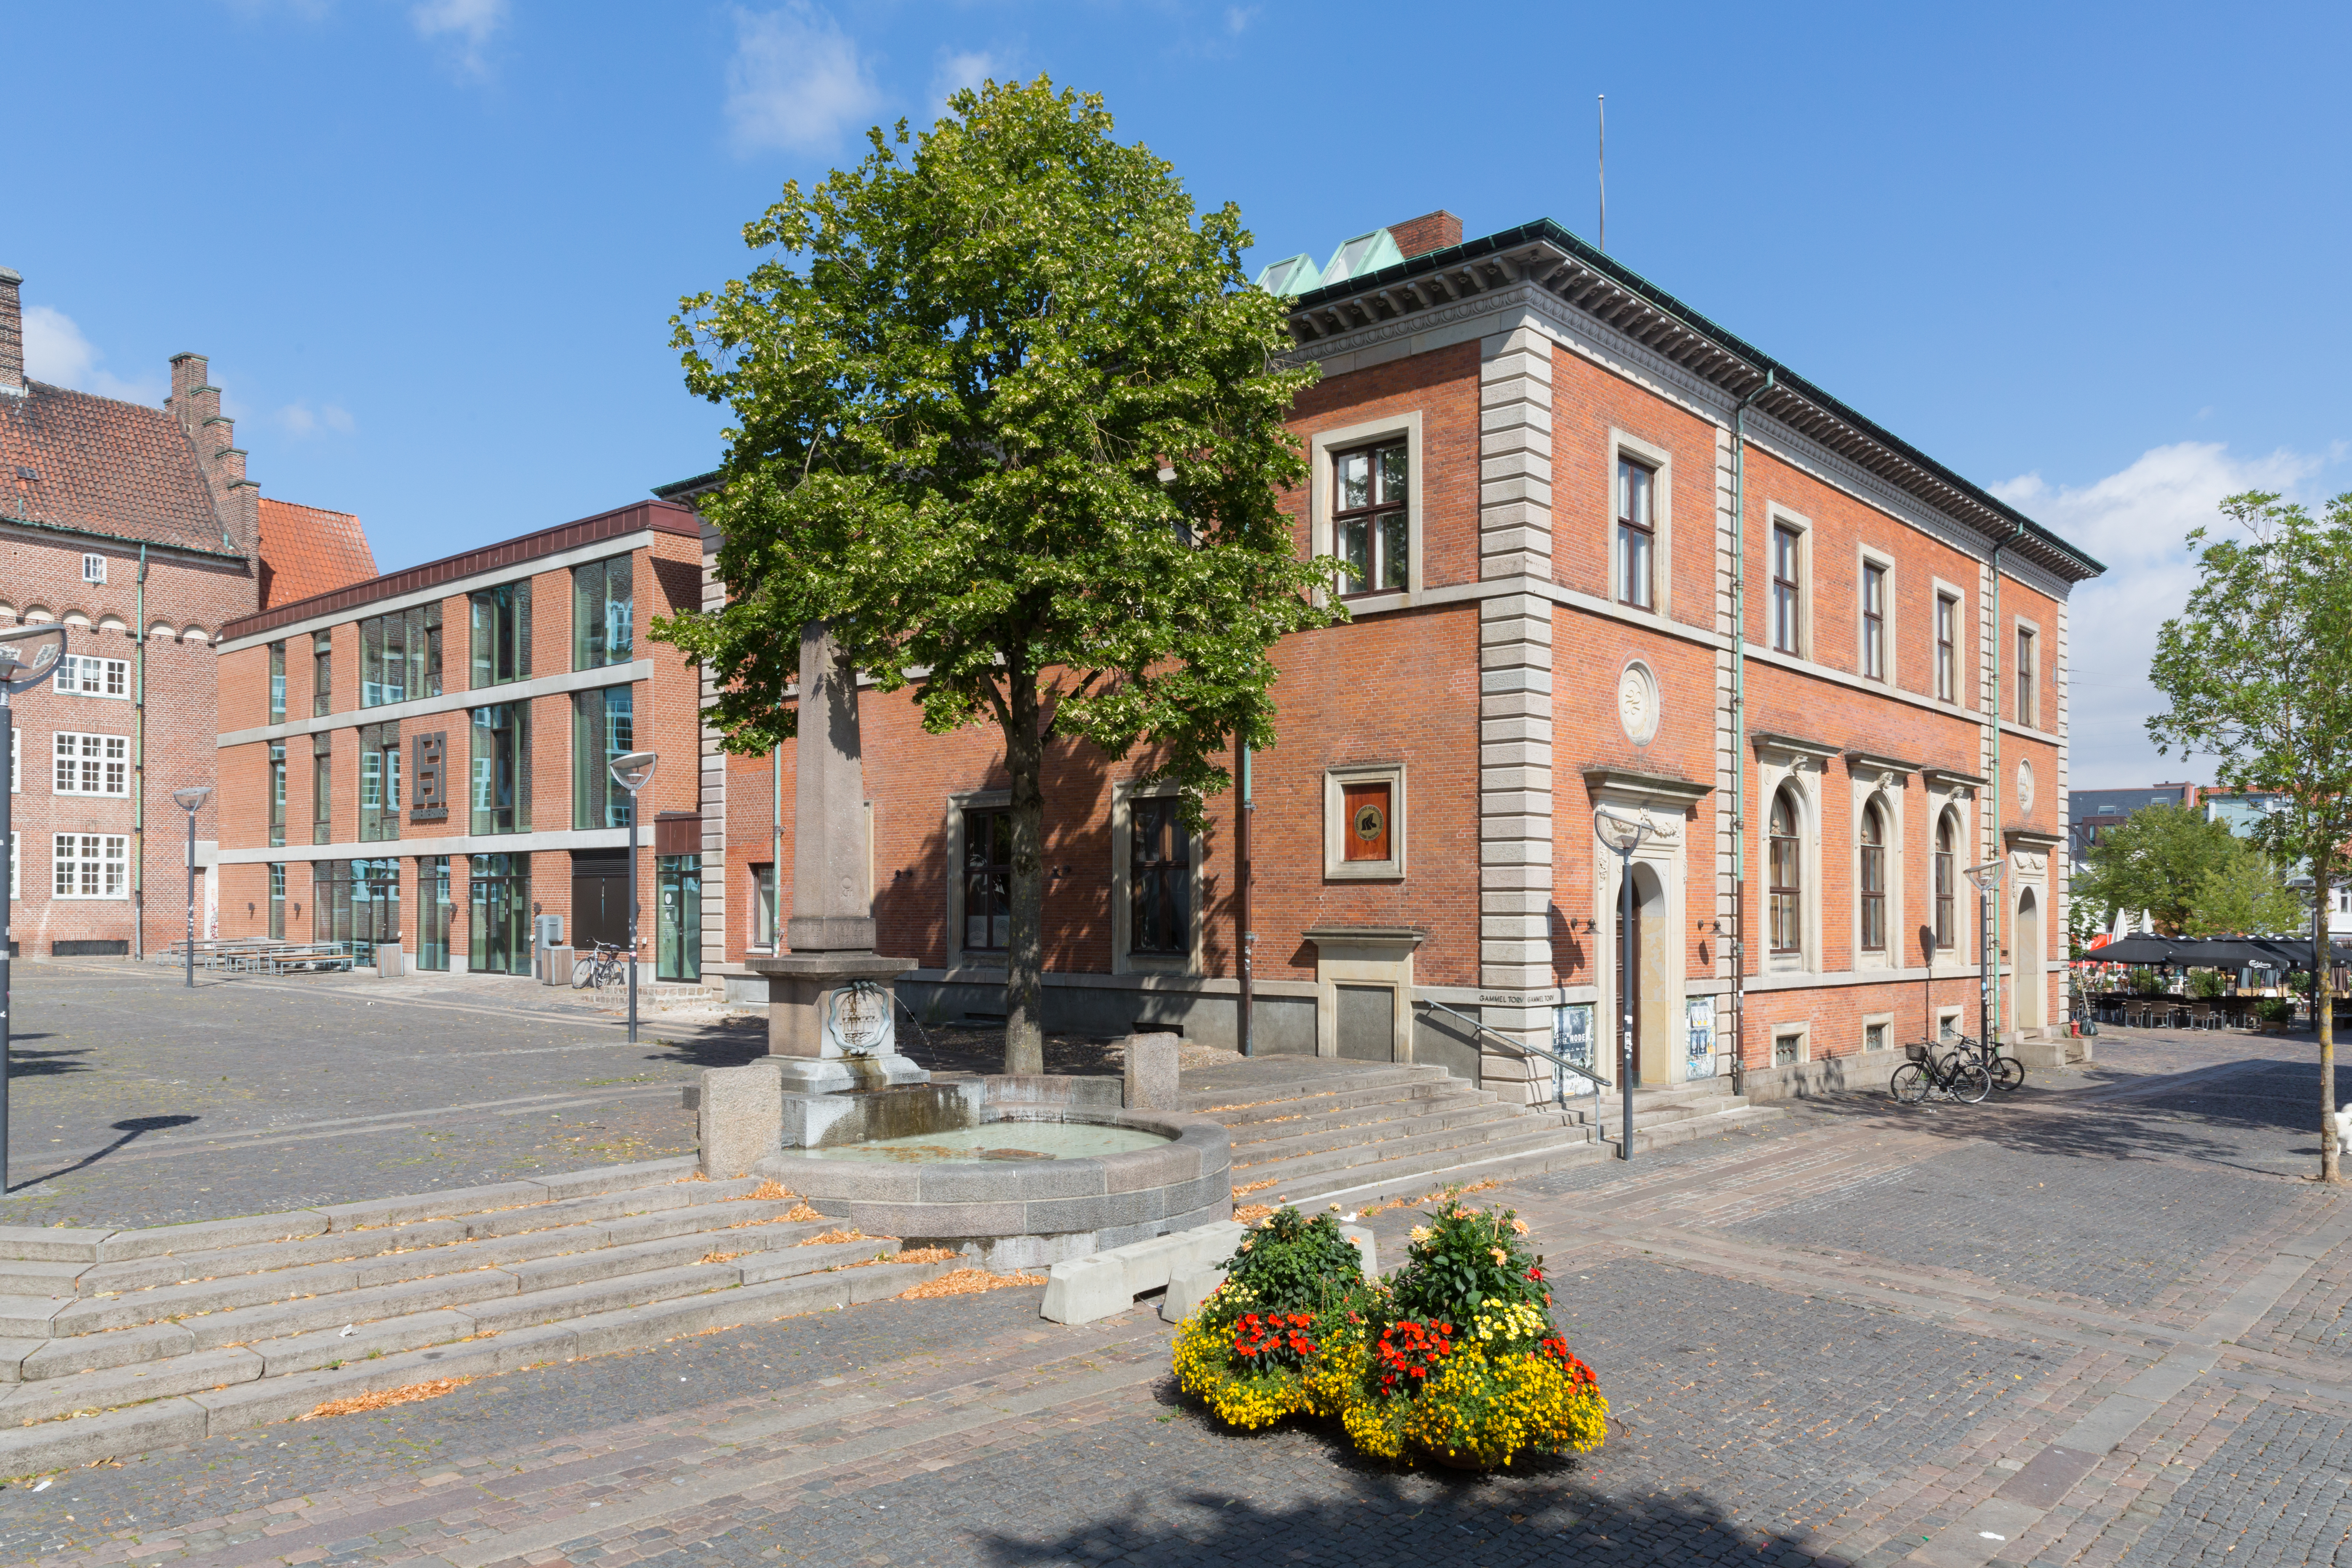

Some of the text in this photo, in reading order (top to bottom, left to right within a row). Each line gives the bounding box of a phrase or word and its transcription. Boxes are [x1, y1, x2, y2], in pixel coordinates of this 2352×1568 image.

[1355, 806, 1383, 830] UNIVERSITAS ALBURGENSIS
[2249, 960, 2271, 968] Carlsberg
[1570, 1034, 1585, 1042] NODE
